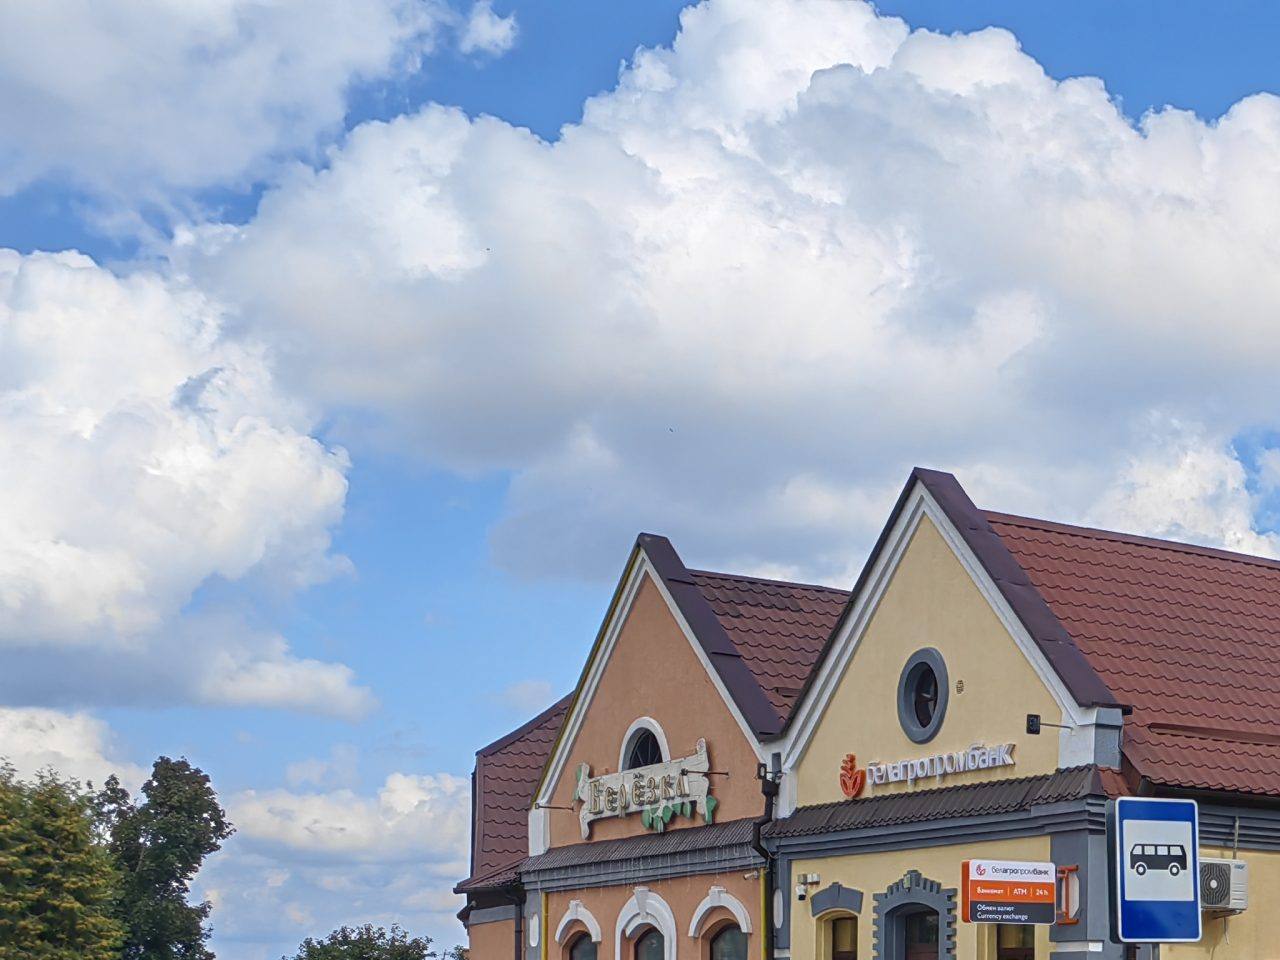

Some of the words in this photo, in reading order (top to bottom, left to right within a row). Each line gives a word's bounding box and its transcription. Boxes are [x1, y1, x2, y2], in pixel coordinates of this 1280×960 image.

[867, 743, 1016, 786] белагропромбанк
[991, 865, 1049, 876] белагропромбанк
[976, 903, 996, 911] Обмен
[976, 912, 1001, 920] Currency
[1003, 913, 1028, 921] exchange
